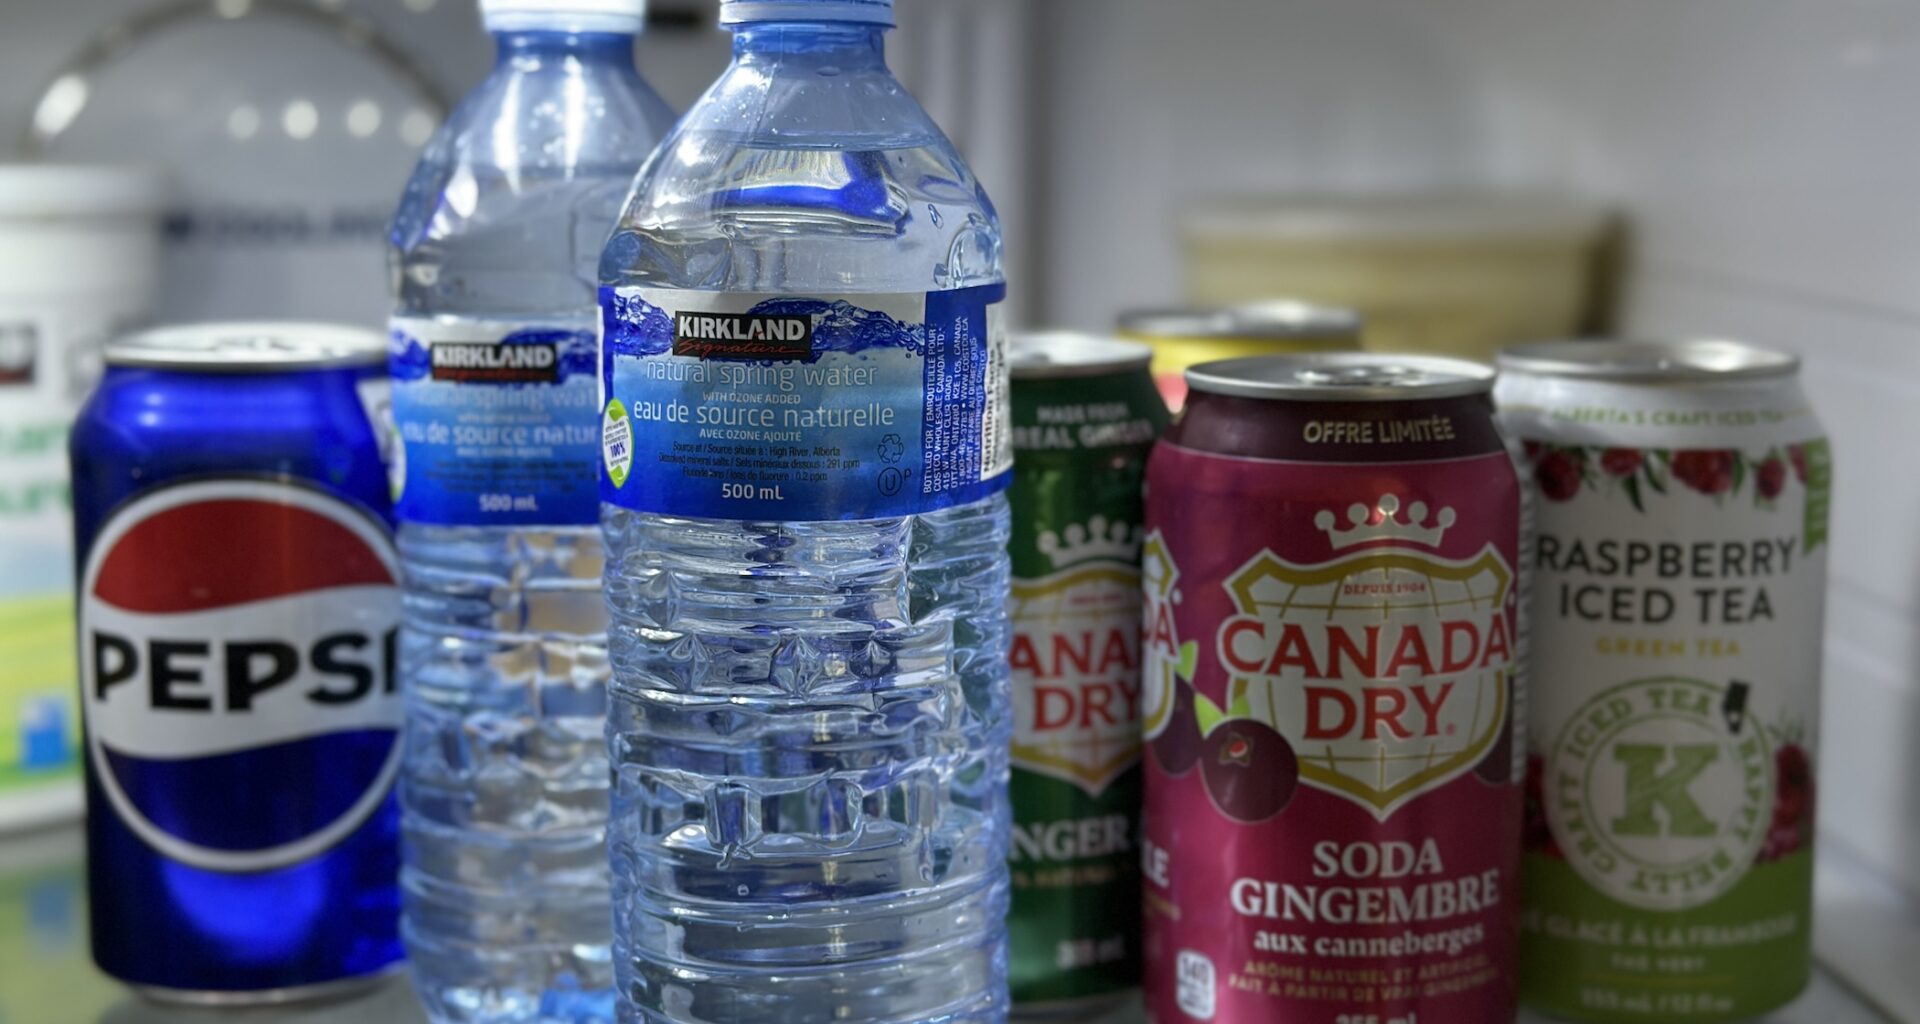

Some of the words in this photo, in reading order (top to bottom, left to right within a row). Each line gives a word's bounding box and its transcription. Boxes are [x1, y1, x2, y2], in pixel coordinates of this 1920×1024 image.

[679, 315, 806, 341] KIRKLAND
[928, 329, 936, 355] POUR
[953, 316, 962, 355] CANADA
[433, 345, 555, 368] KIRKLAND
[677, 338, 806, 358] Signature
[961, 317, 970, 400] WWW.COSTCO.CA
[647, 359, 711, 383] natural
[720, 364, 795, 392] spring
[804, 365, 877, 386] water
[936, 353, 945, 393] CANADA
[952, 381, 961, 400] K2E
[634, 400, 662, 420] eau
[667, 398, 689, 423] de
[696, 405, 775, 427] source
[784, 402, 895, 428] naturelle
[703, 391, 728, 402] WITH
[729, 392, 763, 404] OZONE
[765, 394, 801, 405] ADDED
[453, 424, 529, 445] source
[699, 428, 724, 439] AVEC
[726, 429, 760, 441] OZONE
[925, 430, 934, 450] FOR
[934, 395, 944, 452] WHOLESALE
[951, 404, 960, 445] ONTARIO
[983, 400, 994, 473] Nutrition
[1302, 420, 1374, 444] OFFRE
[1378, 414, 1456, 444] LIMITÉE
[769, 446, 787, 458] High
[813, 446, 841, 457] Alberta
[721, 482, 755, 499] 500
[760, 484, 784, 500] mL
[923, 451, 933, 493] BOTTLED
[933, 454, 942, 492] COSTCO
[1535, 533, 1796, 579] RASPBERRY
[1344, 583, 1394, 596] DEPUIS
[1560, 582, 1676, 625] ICED
[1694, 585, 1775, 625] TEA
[1008, 626, 1143, 680] ANA
[1222, 613, 1512, 680] CANADA
[1594, 636, 1687, 656] GREEN
[1695, 637, 1742, 656] TEA
[1033, 680, 1141, 733] DRY
[1302, 682, 1455, 741] DRY
[1565, 696, 1633, 761] ICED
[1611, 742, 1720, 838] K
[1311, 837, 1444, 879] SODA
[1230, 868, 1500, 925] GINGEMBRE
[1253, 929, 1308, 955] aux
[1314, 921, 1484, 957] canneberges
